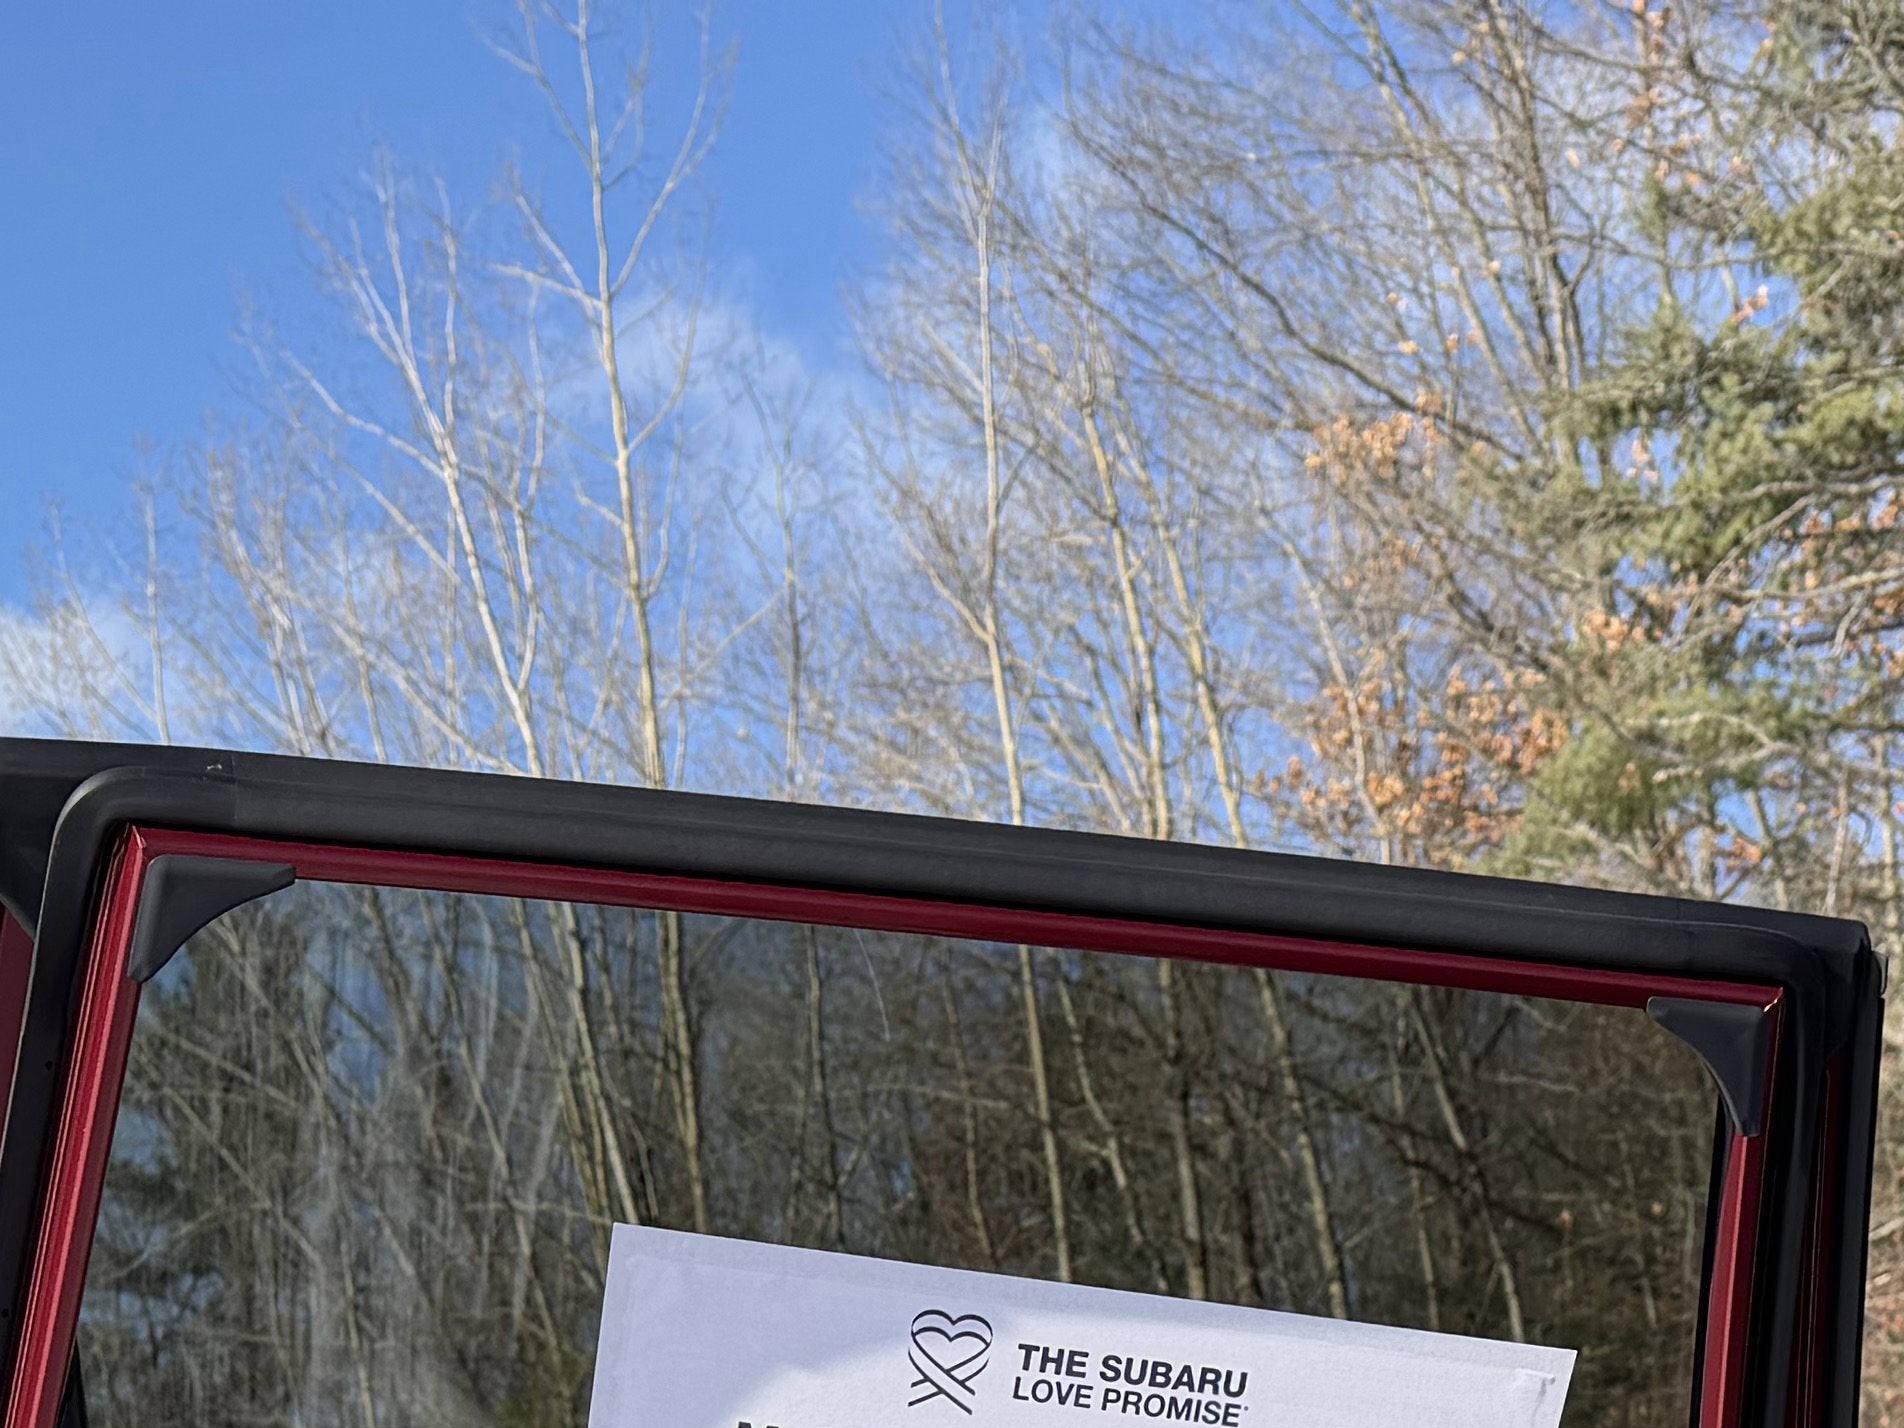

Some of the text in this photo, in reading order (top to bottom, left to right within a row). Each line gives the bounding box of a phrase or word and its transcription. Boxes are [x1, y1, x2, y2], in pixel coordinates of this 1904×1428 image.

[1017, 1342, 1248, 1398] THE SUBARU
[1011, 1375, 1242, 1427] LOVE PROMISE
